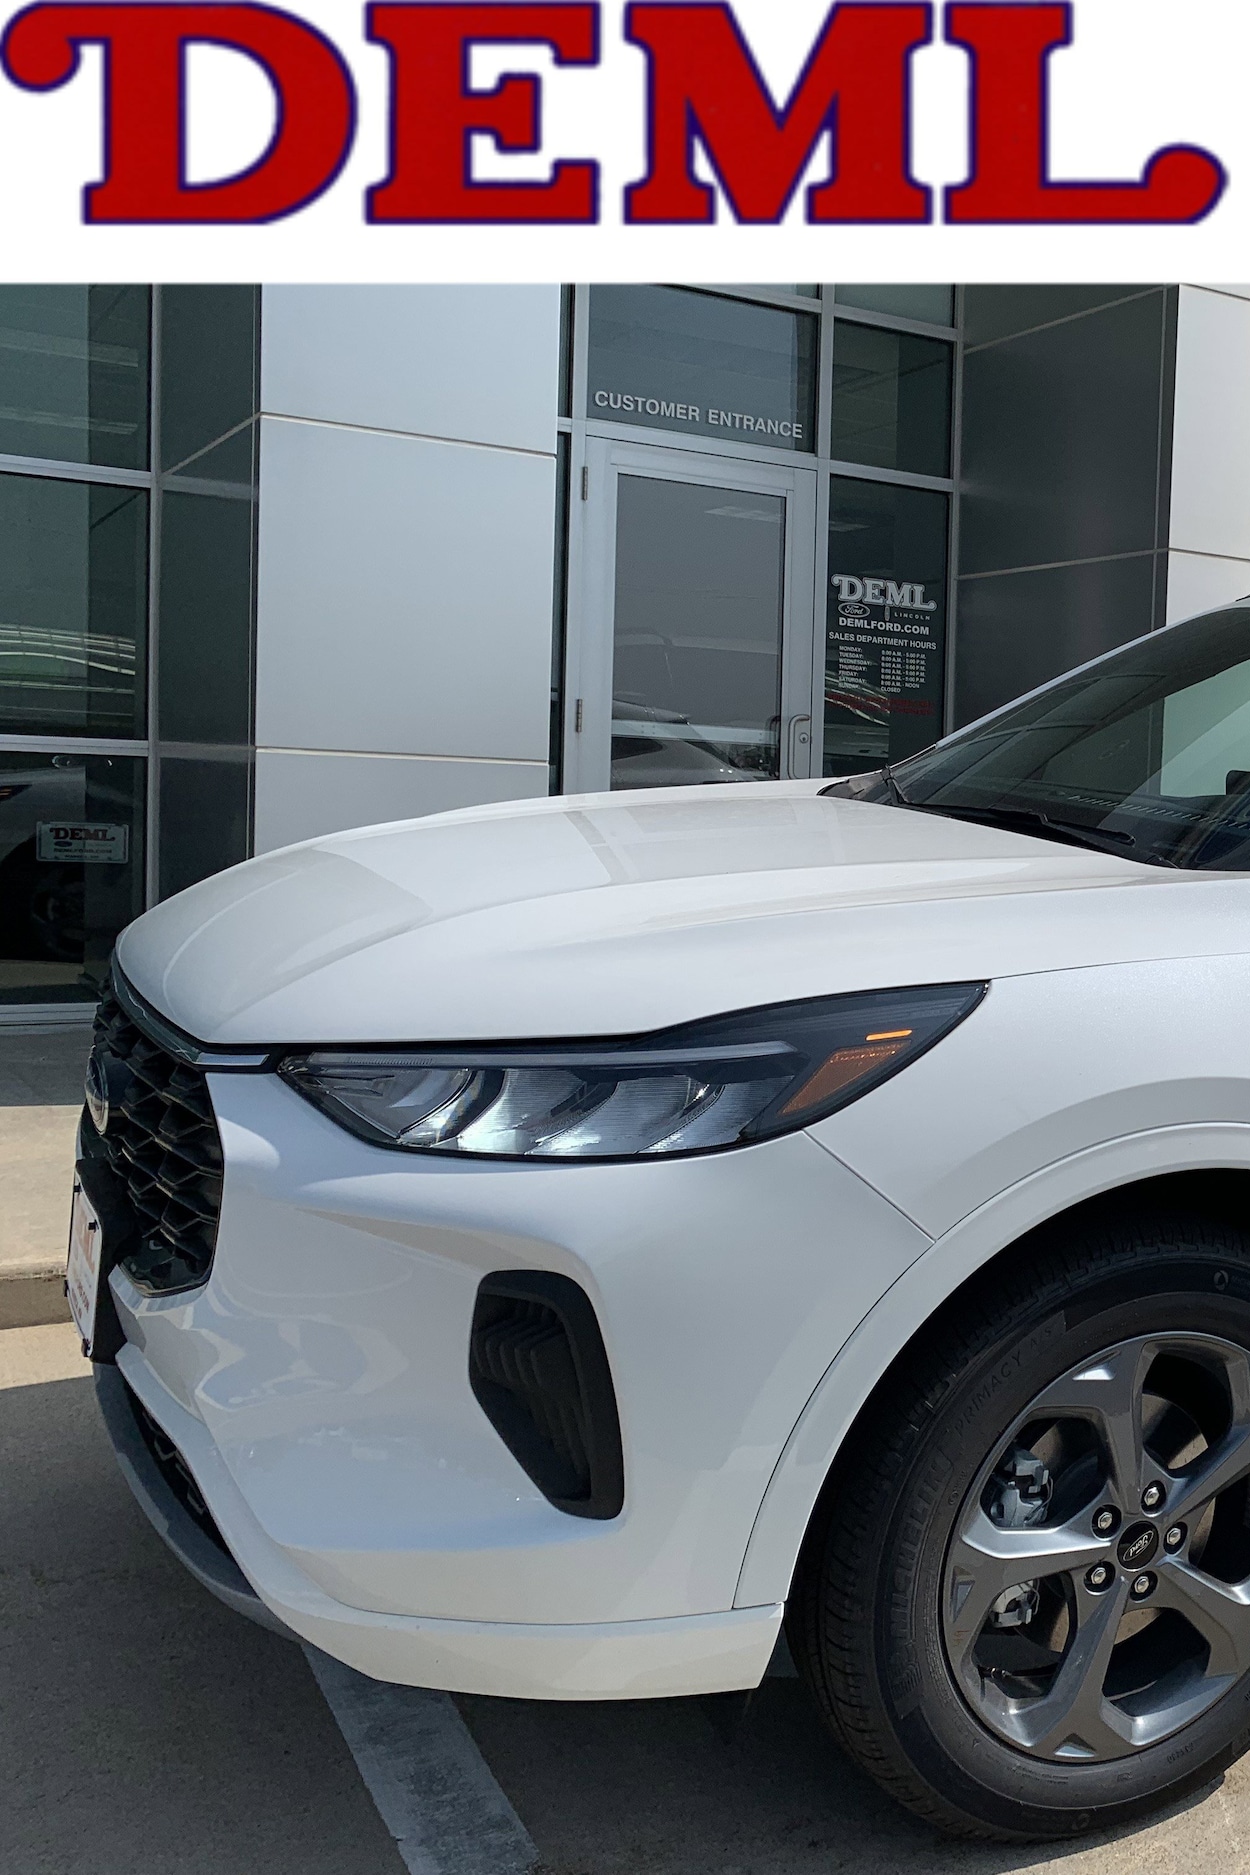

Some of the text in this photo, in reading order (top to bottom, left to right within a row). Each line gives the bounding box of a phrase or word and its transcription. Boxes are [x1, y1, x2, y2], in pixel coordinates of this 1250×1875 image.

[594, 390, 803, 439] CUSTOMER ENTRANCE
[831, 574, 938, 612] DEML
[845, 605, 864, 615] Ford
[894, 611, 931, 621] LINCOLN
[839, 617, 930, 636] DEMLFORD.COM
[828, 631, 937, 651] SALES DEPARTMENT HOURS
[50, 827, 116, 842] DEML
[954, 1351, 1023, 1437] PRIMACY
[890, 1459, 946, 1639] MICHELIN
